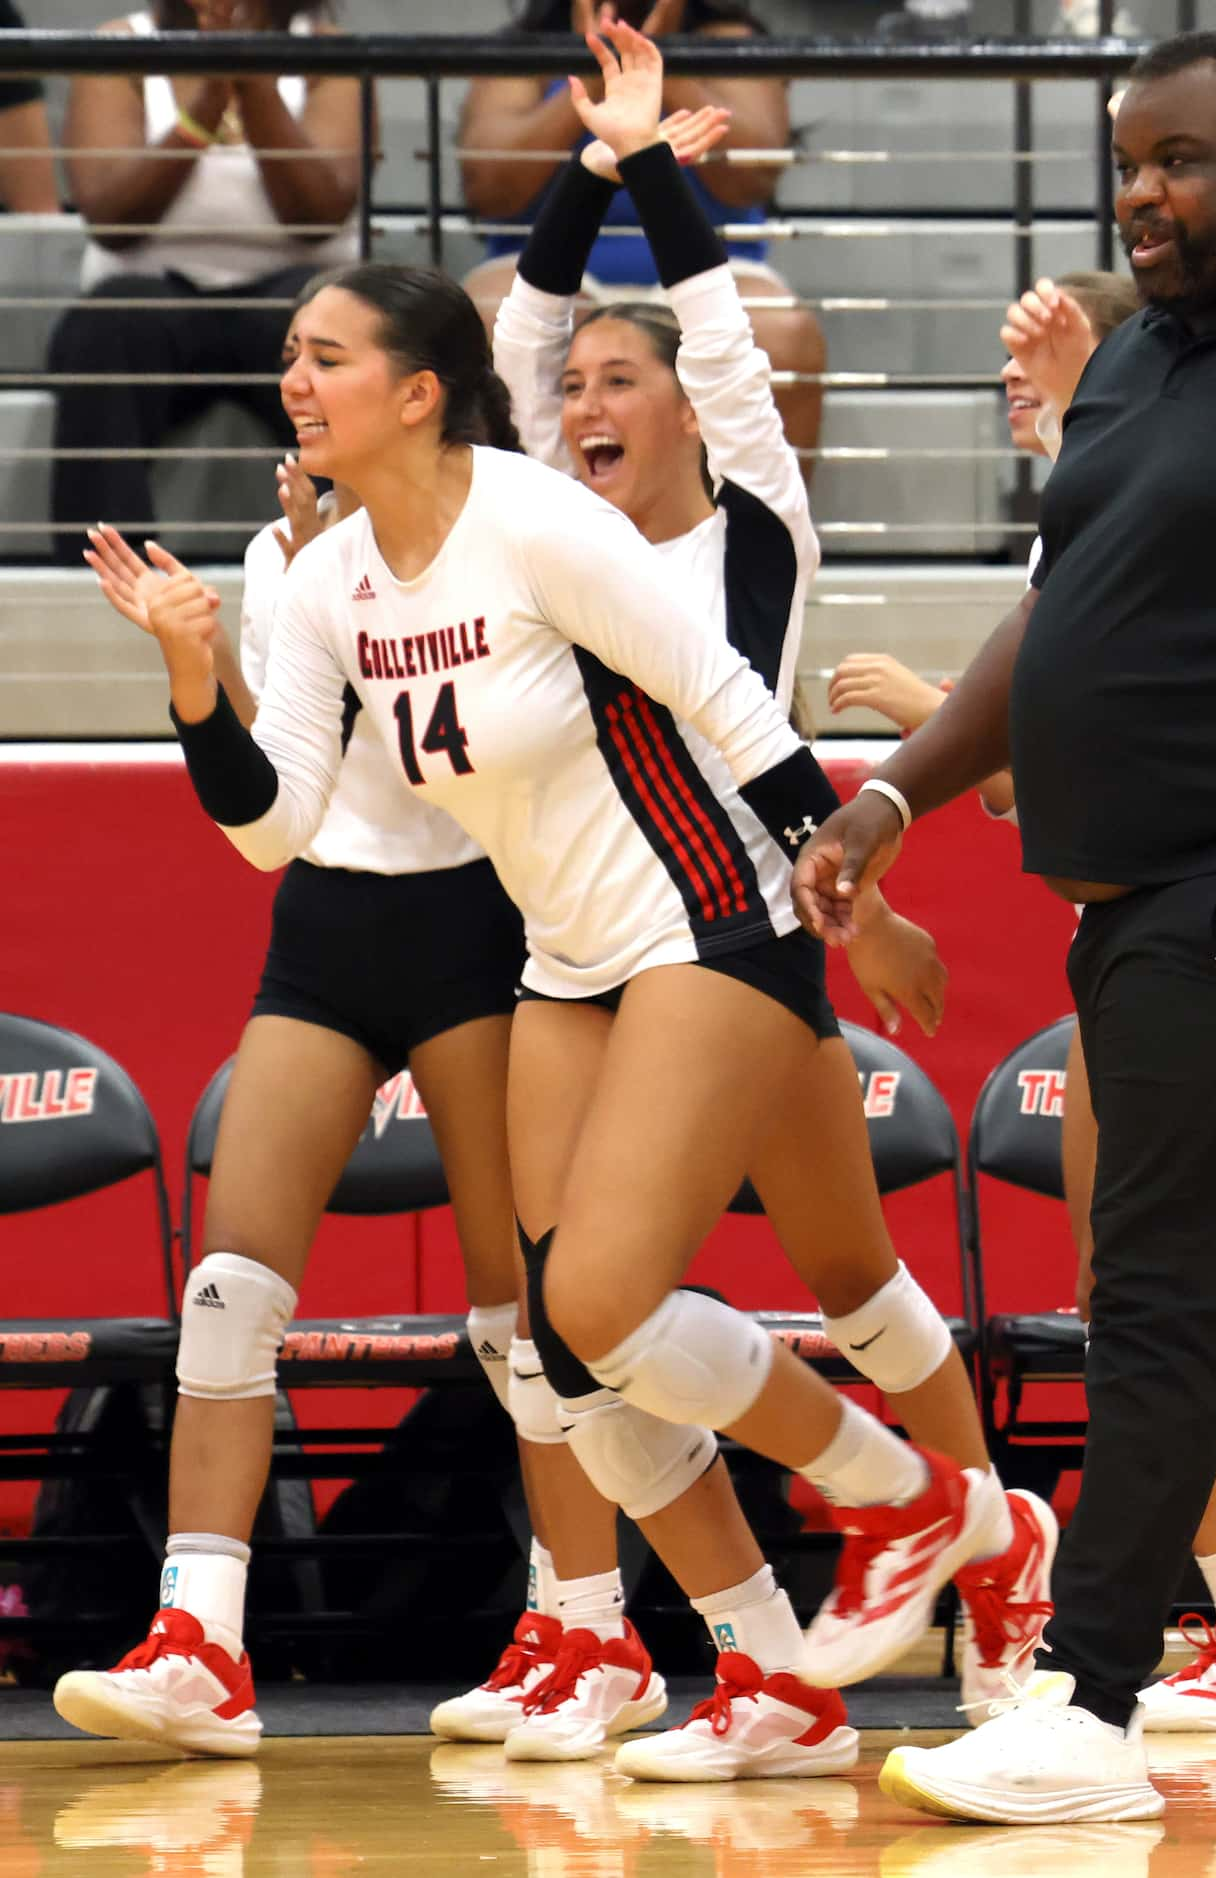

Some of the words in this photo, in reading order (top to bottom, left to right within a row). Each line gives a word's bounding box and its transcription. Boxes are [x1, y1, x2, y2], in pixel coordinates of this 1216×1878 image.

[356, 616, 491, 680] COLLEYVILLE
[392, 680, 476, 786] 14
[0, 1067, 98, 1124] ILLE
[279, 1332, 459, 1361] PANTHERS
